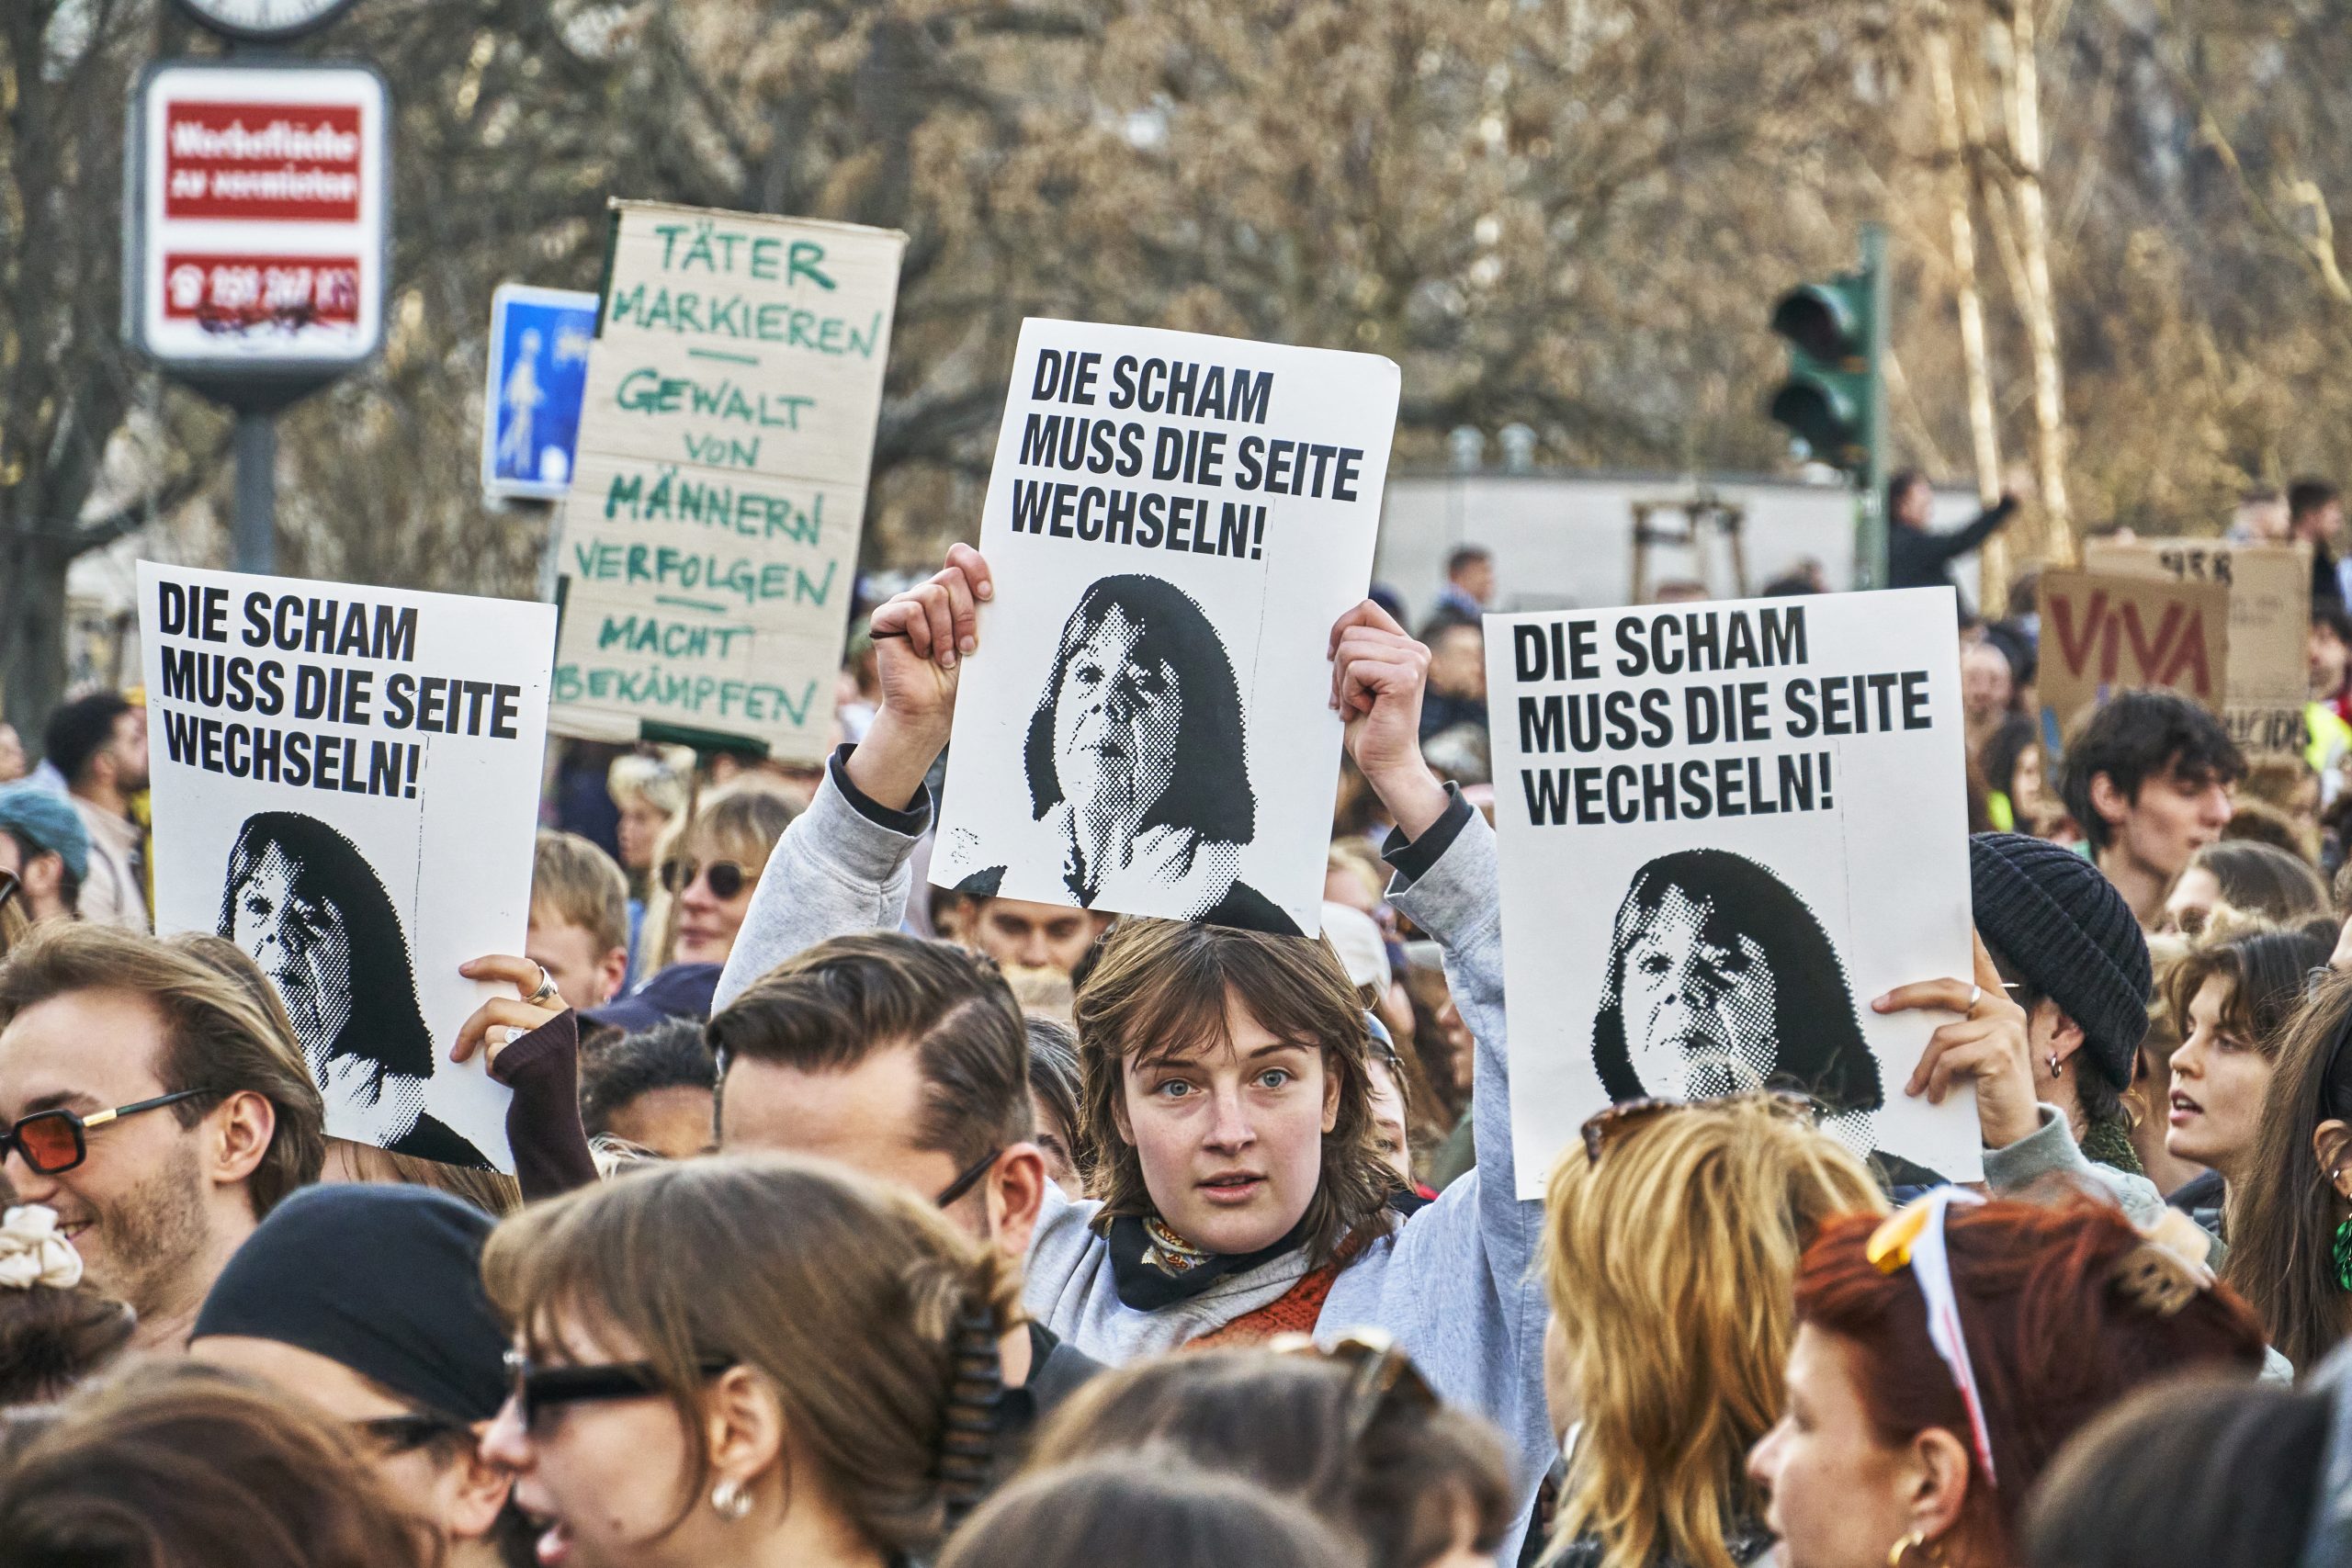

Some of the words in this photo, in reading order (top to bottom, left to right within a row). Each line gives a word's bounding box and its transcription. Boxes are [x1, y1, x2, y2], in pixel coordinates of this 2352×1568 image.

[654, 219, 837, 289] TÄTER
[612, 283, 882, 358] MARKIEREN
[616, 367, 816, 432] GEWALT
[1032, 348, 1102, 405] DIE
[1109, 355, 1273, 424] SCHAM
[684, 432, 761, 467] VON
[1019, 413, 1145, 477] MUSS
[1152, 426, 1227, 486] DIE
[1235, 435, 1364, 502] SEITE
[605, 464, 825, 547] MÄNNERN
[1012, 479, 1266, 560] WECHSELN!
[575, 541, 837, 605] VERFOLGEN
[159, 581, 228, 642] DIE
[242, 592, 418, 661] SCHAM
[598, 615, 754, 660] MACHT
[1513, 620, 1600, 682] DIE
[1615, 605, 1809, 677] SCHAM
[2050, 589, 2211, 697] VIVA
[161, 646, 285, 716] MUSS
[295, 664, 373, 725] DIE
[383, 673, 520, 739] SEITE
[555, 662, 817, 727] BEKÄMPFEN
[1518, 688, 1674, 753] MUSS
[1685, 682, 1771, 745] DIE
[1785, 671, 1932, 739] SEITE
[164, 709, 420, 799] WECHSELN!
[1521, 751, 1833, 826] WECHSELN!
